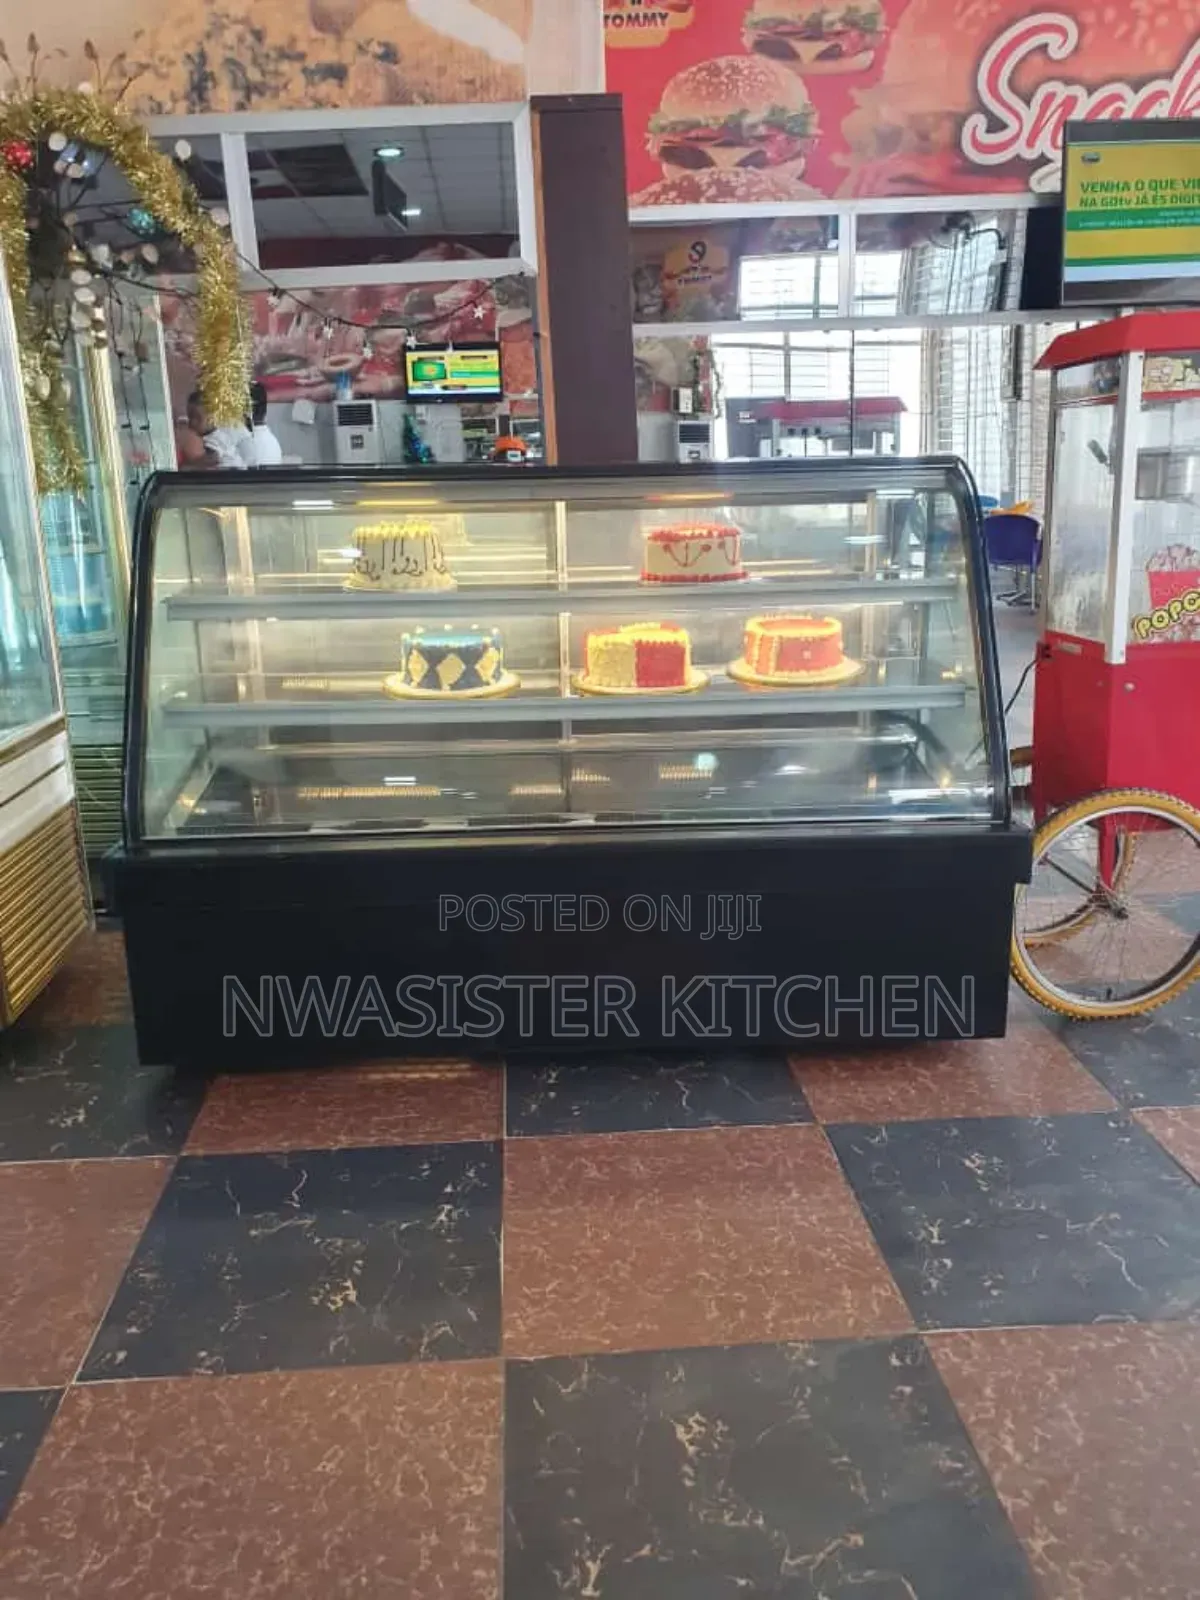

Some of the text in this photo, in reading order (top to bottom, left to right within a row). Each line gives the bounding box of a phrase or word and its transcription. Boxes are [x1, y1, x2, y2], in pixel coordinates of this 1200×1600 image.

[1080, 180, 1131, 193] VENHA
[1135, 179, 1145, 191] O
[1148, 178, 1178, 194] QUE
[1079, 196, 1097, 207] NA
